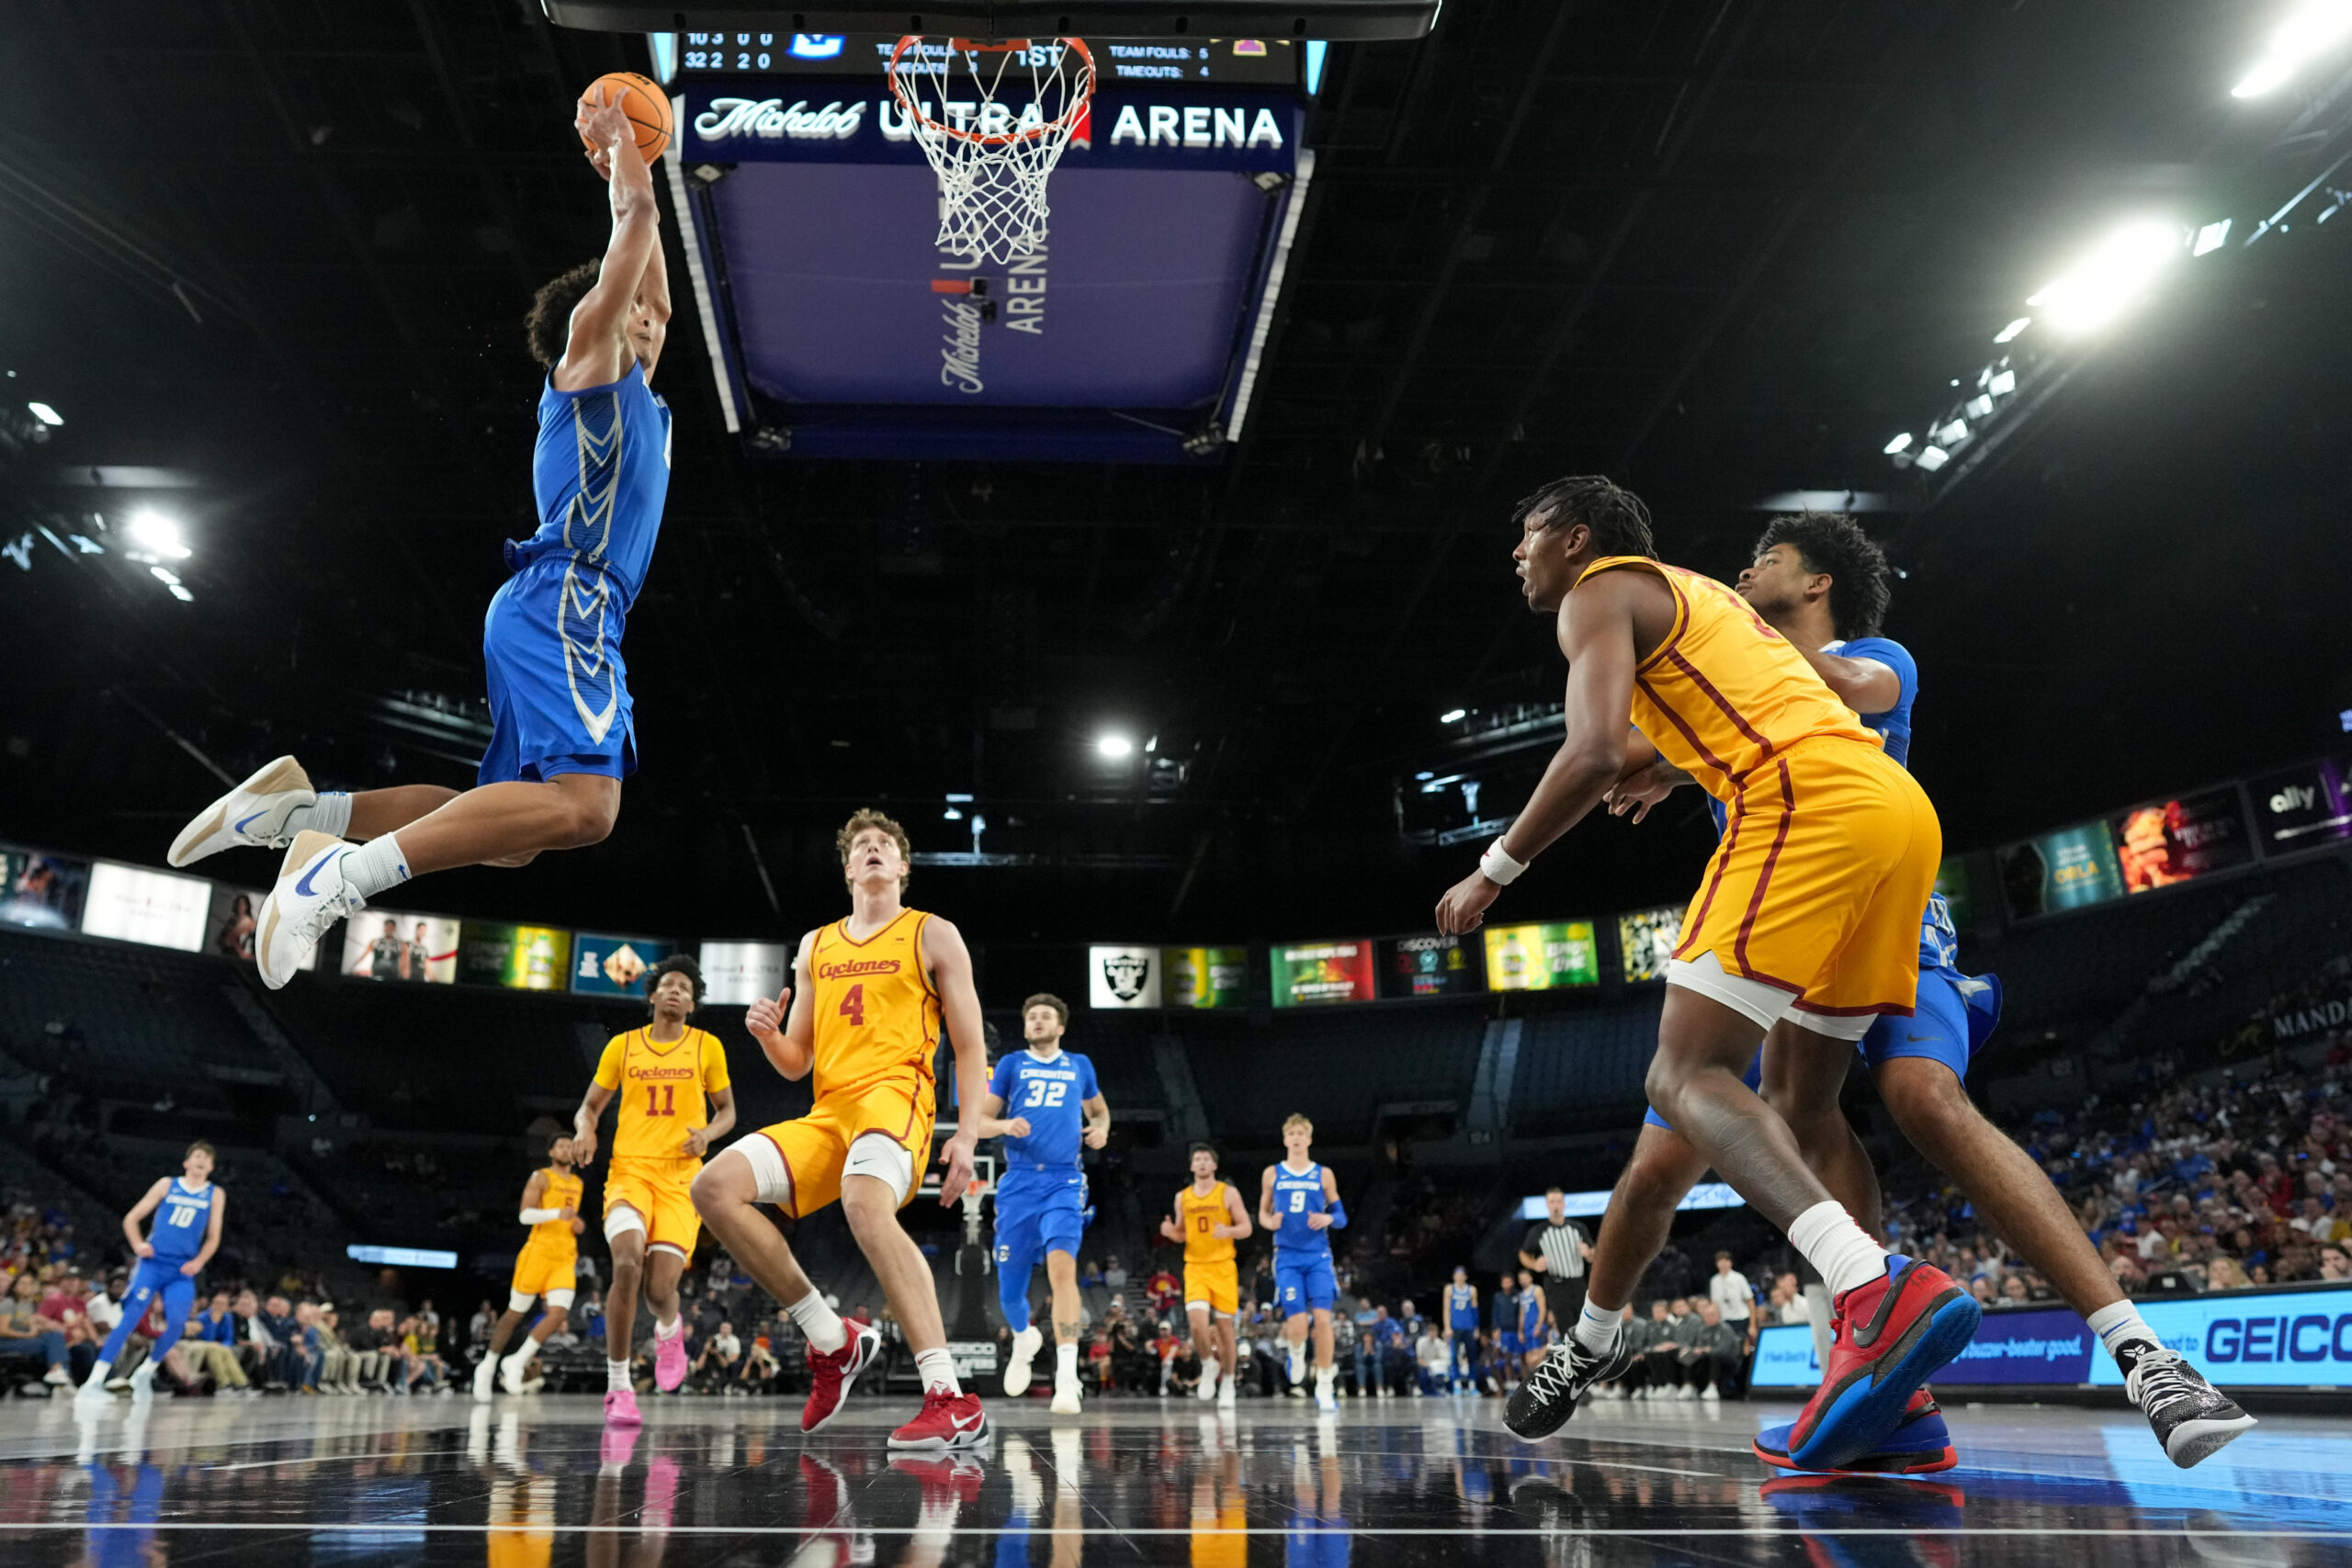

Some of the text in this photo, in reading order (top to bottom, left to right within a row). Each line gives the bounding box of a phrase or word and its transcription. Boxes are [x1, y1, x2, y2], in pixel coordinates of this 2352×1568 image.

[684, 51, 771, 70] 32 2 2 0
[1016, 45, 1063, 67] 1ST
[1109, 45, 1208, 60] TEAM FOULS: 5
[1115, 64, 1209, 78] TIMEOUTS: 4
[694, 97, 1283, 150] Michelob ULTRA ARENA
[1005, 228, 1050, 335] ARENA
[940, 299, 984, 394] Michelob
[2269, 785, 2315, 814] ally
[819, 959, 901, 981] Cyclones
[839, 983, 864, 1027] 4
[628, 1066, 695, 1080] Cyclones
[646, 1085, 675, 1117] 11
[1023, 1079, 1067, 1108] 32
[1289, 1190, 1306, 1213] 9
[168, 1205, 197, 1228] 10
[1198, 1216, 1209, 1233] 0
[2045, 1335, 2083, 1362] good.
